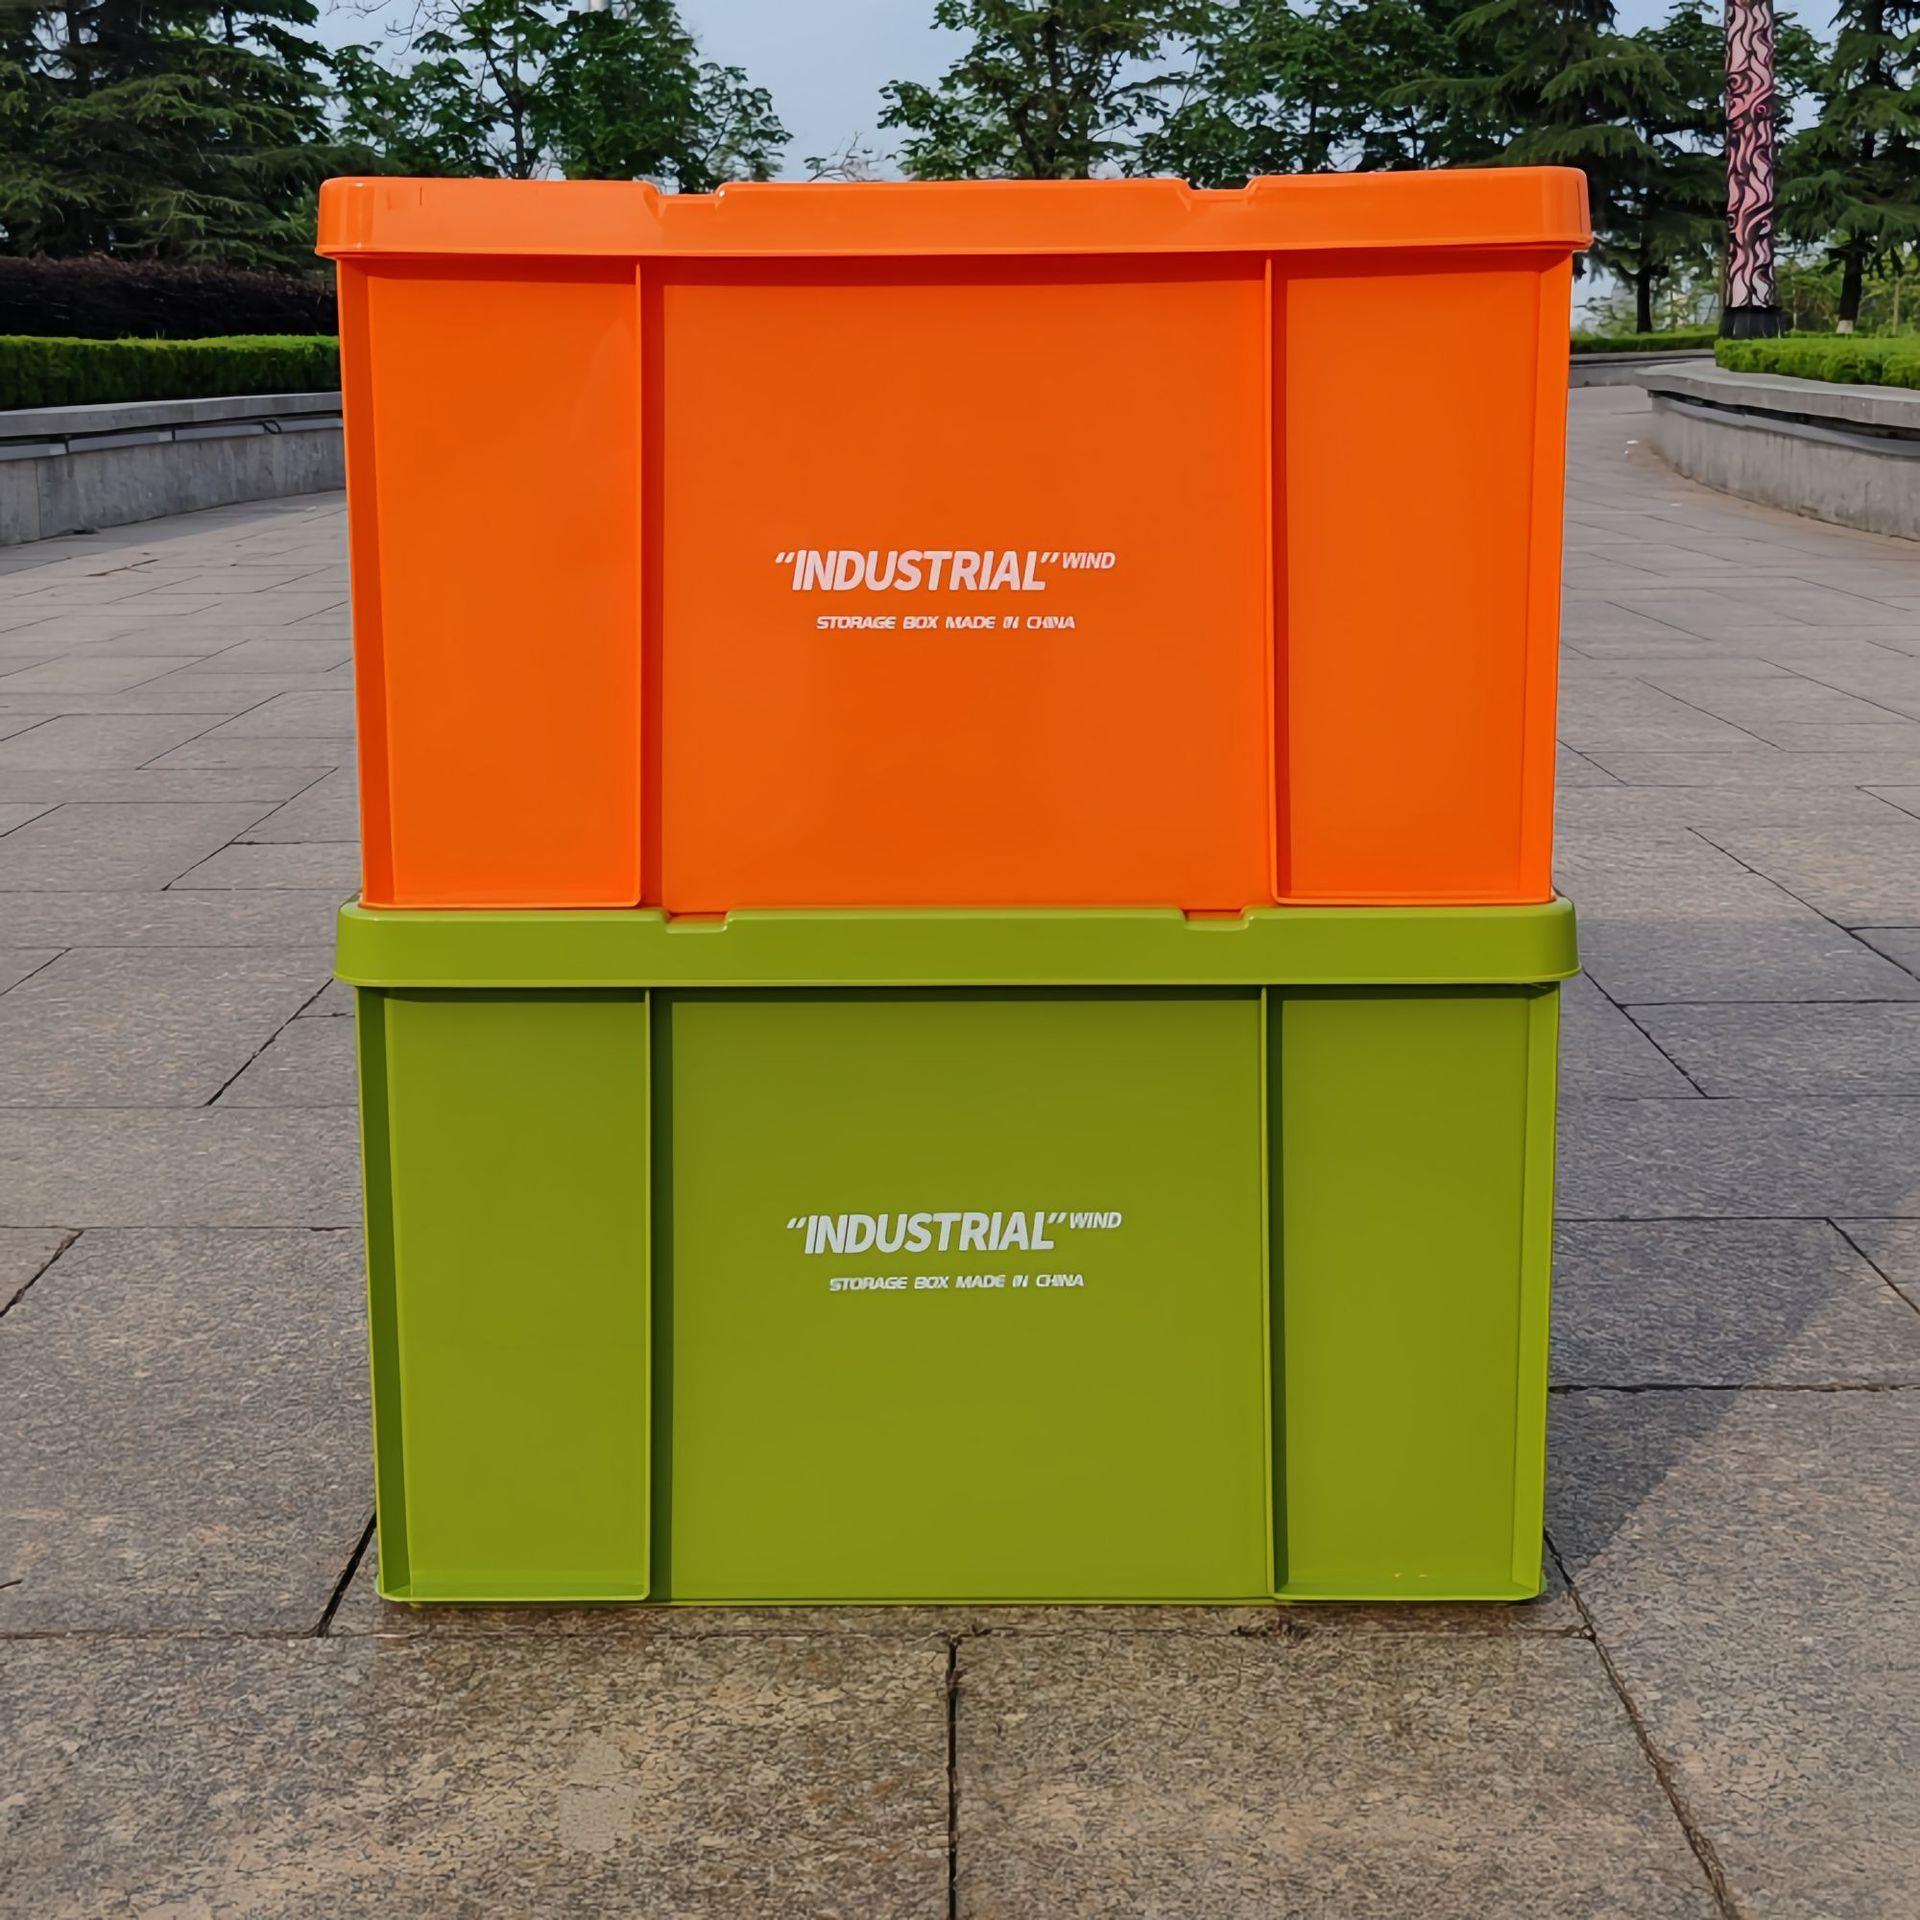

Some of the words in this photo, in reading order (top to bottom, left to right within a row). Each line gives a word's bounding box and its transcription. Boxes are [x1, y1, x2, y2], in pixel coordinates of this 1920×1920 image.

[1063, 552, 1115, 569] WIND
[817, 616, 896, 629] STORAGE
[903, 616, 938, 629] BOX
[946, 616, 995, 628] MADE
[1003, 616, 1019, 628] IN
[1027, 616, 1075, 629] CHINA
[1070, 1212, 1122, 1229] WIND
[830, 1277, 908, 1291] STORAGE
[914, 1276, 949, 1289] BOX
[956, 1275, 1005, 1288] MADE
[1012, 1275, 1028, 1287] IN
[1036, 1274, 1084, 1287] CHINA
